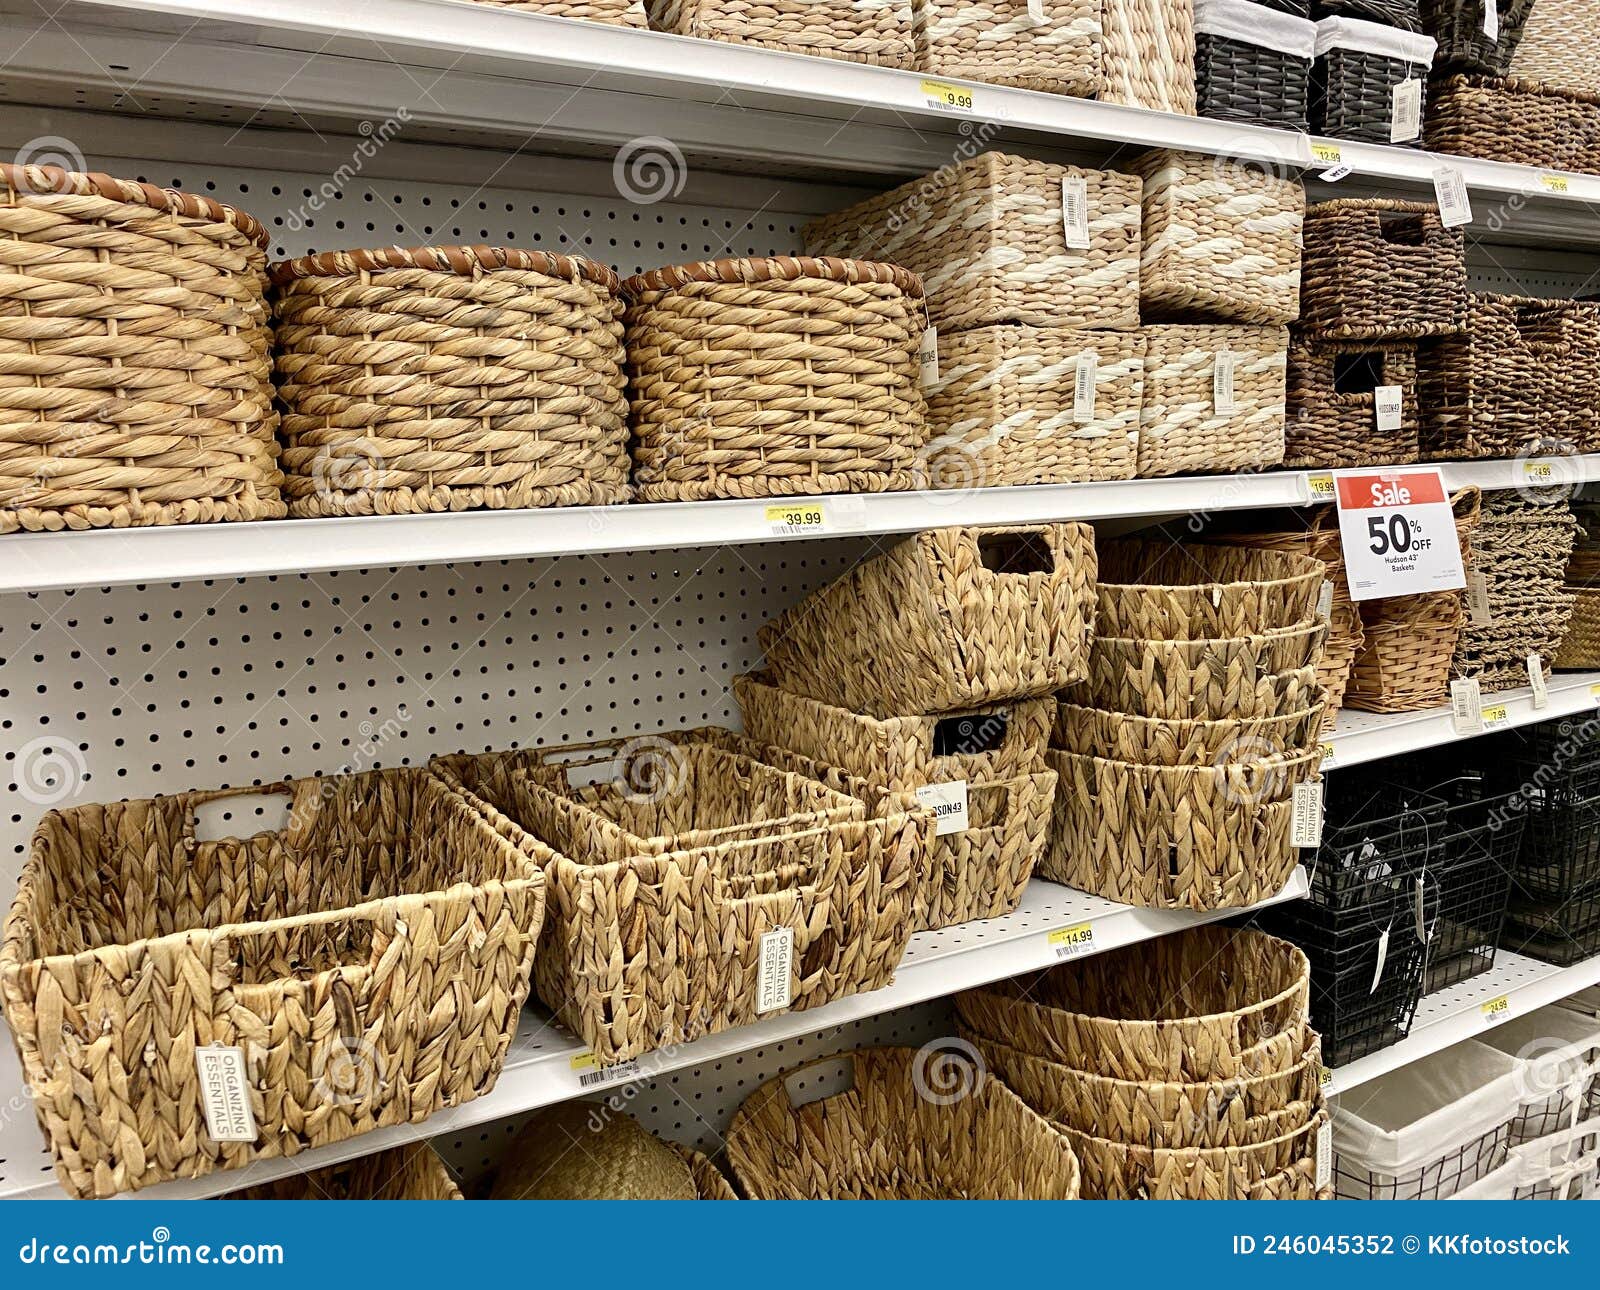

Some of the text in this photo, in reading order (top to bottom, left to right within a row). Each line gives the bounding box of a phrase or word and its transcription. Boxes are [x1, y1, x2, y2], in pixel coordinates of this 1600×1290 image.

[1370, 481, 1411, 507] Sale
[1384, 555, 1408, 564] Hudson
[1391, 563, 1415, 572] Baskets
[1411, 538, 1432, 551] OFF
[1295, 788, 1306, 842] ESSENTIALS
[1307, 788, 1318, 842] ORGANIZING
[763, 938, 776, 1006] ESSENTIALS
[776, 935, 788, 1003] ORGANIZING
[204, 1056, 230, 1134] ESSENTIALS
[223, 1055, 247, 1133] ORGANIZING
